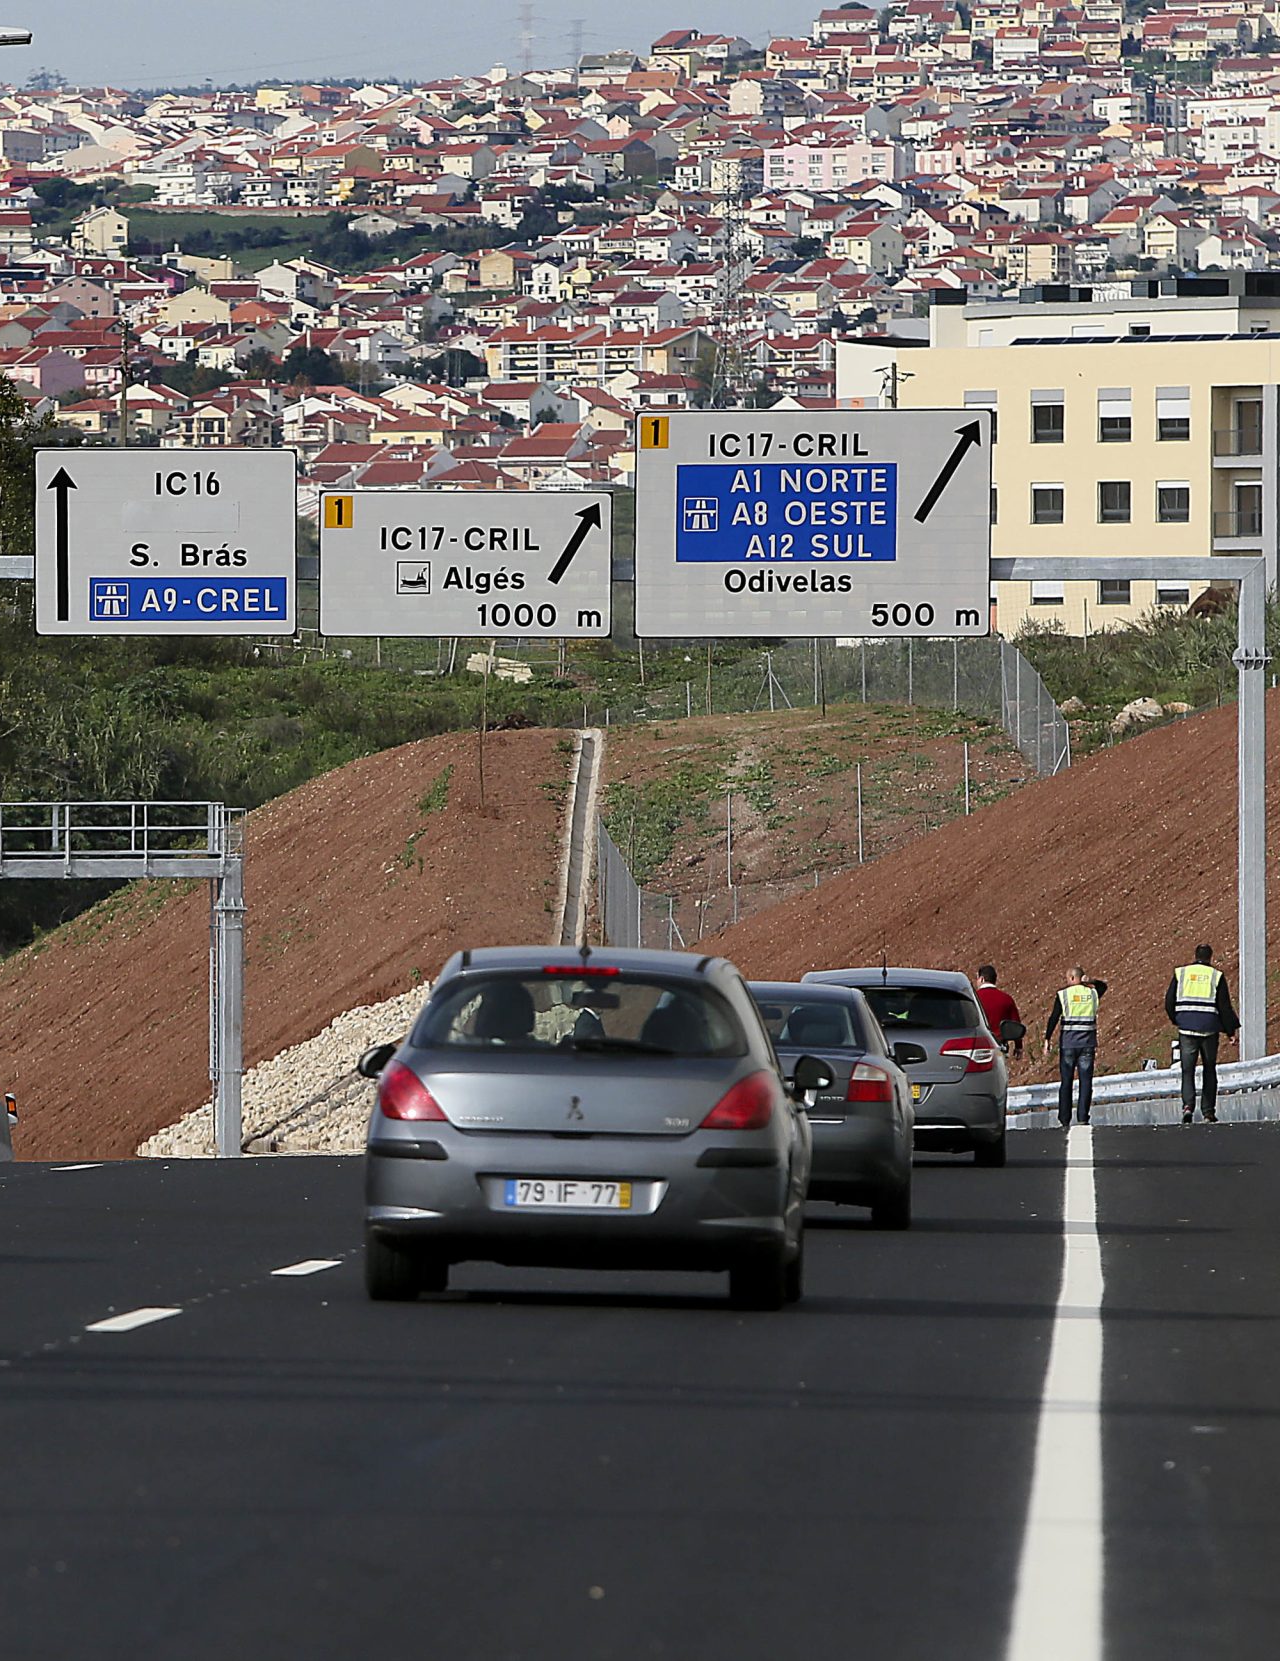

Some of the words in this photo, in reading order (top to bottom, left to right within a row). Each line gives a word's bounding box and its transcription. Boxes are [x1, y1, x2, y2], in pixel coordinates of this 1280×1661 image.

[650, 419, 661, 446] 1
[710, 433, 869, 458] IC17-CRIL
[155, 471, 220, 496] IC16
[730, 468, 761, 493] A1
[780, 468, 887, 493] NORTE
[332, 498, 344, 526] 1
[731, 501, 767, 526] A8
[784, 501, 887, 526] OESTE
[381, 526, 540, 551] IC17-CRIL
[745, 534, 795, 558] A12
[810, 534, 872, 558] SUL
[129, 543, 159, 567] S.
[181, 543, 247, 567] Brás
[442, 566, 525, 594] Algés
[724, 569, 852, 593] Odivelas
[140, 587, 279, 613] A9-CREL
[477, 603, 557, 628] 1000
[577, 610, 602, 628] m
[871, 603, 935, 627] 500
[955, 609, 980, 626] m
[1081, 994, 1092, 1002] EP
